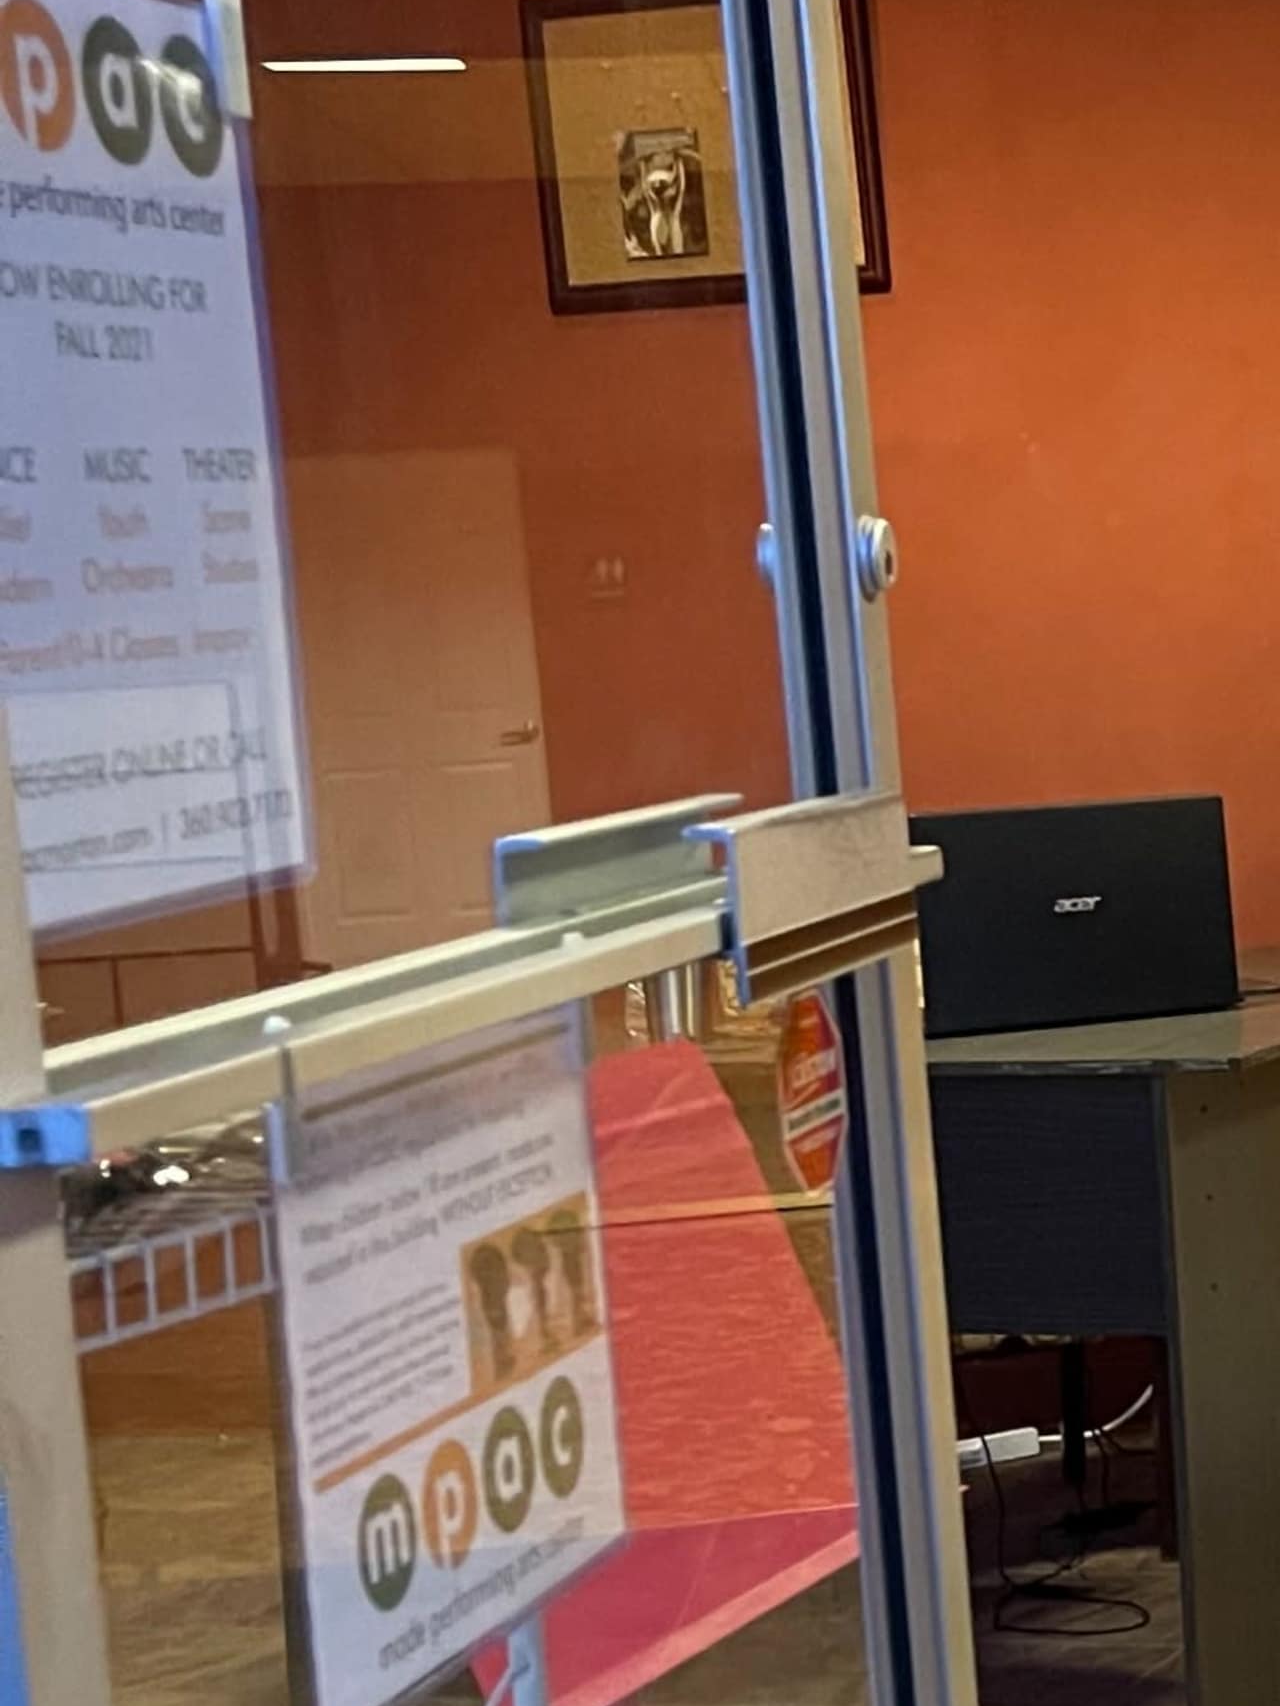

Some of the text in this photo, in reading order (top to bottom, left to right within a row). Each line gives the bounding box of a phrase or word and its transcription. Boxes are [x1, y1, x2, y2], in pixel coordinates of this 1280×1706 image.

[48, 265, 165, 313] ENROLLING
[167, 276, 209, 314] FOR
[54, 319, 156, 362] FALL 2021
[83, 448, 152, 483] MUSIC
[1053, 896, 1102, 913] acer
[365, 1404, 572, 1586] mpac
